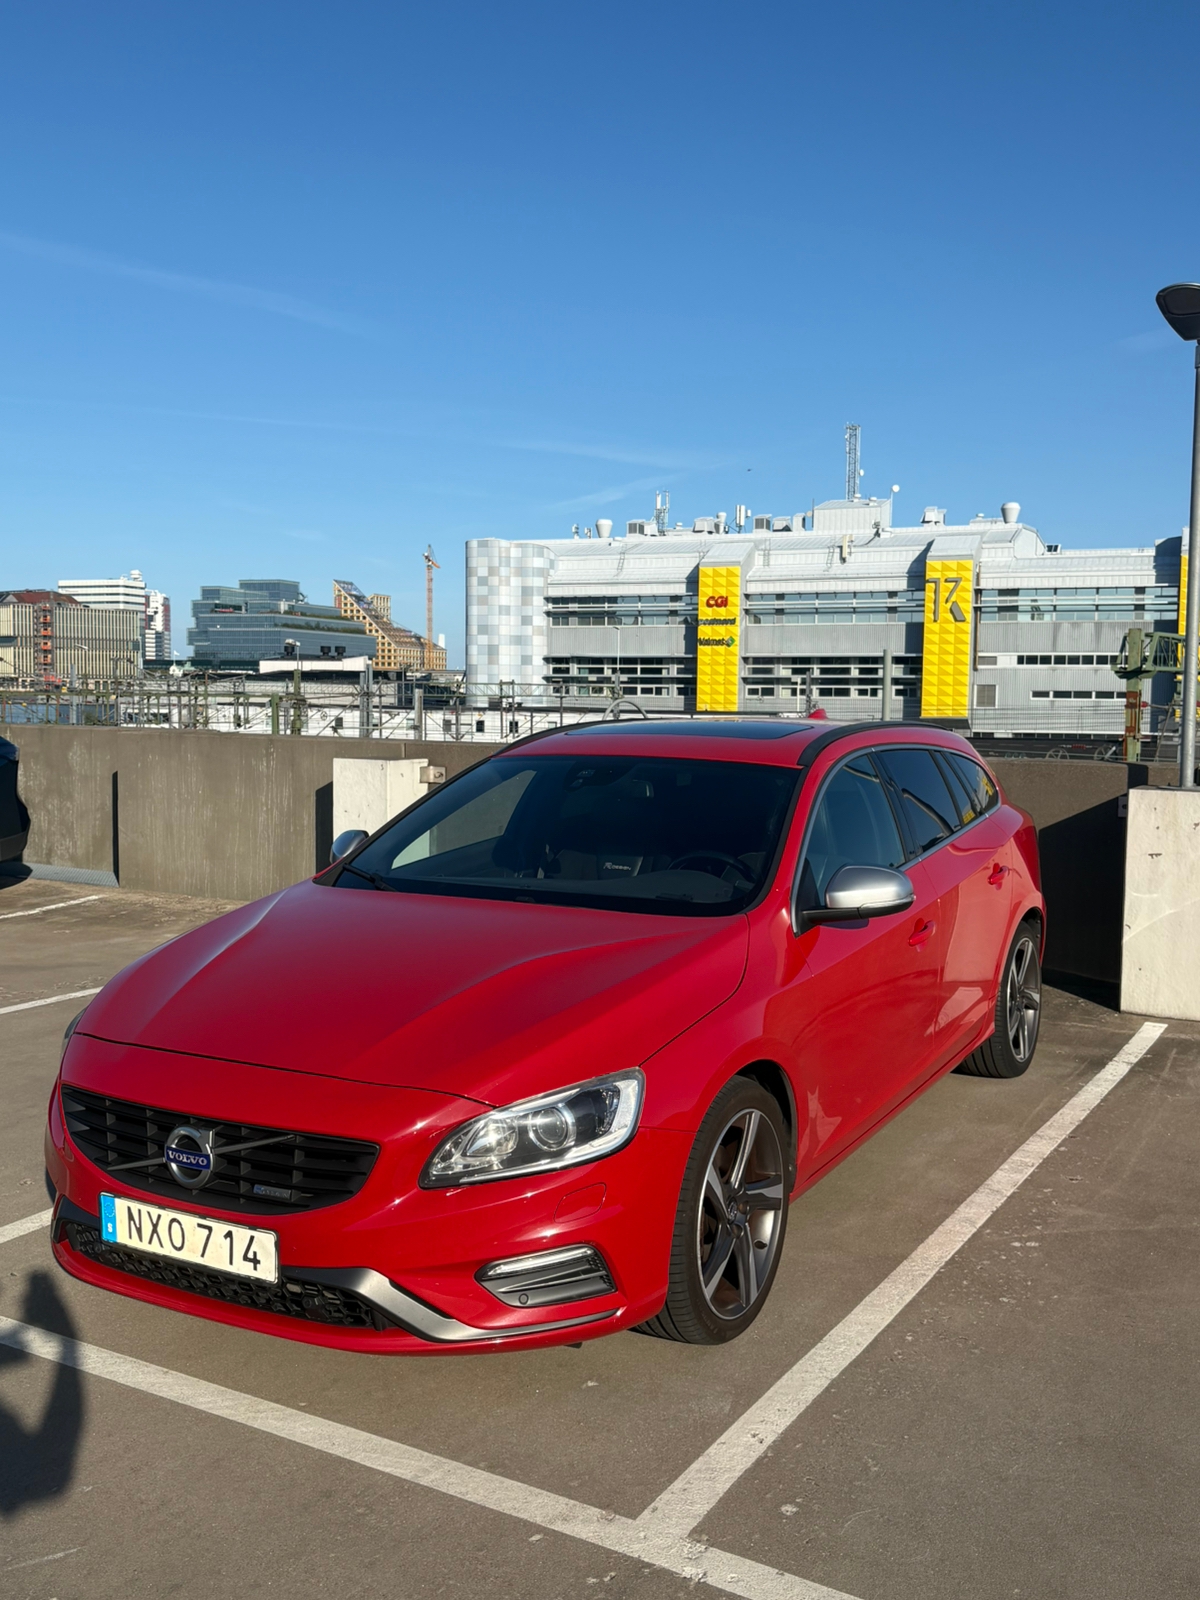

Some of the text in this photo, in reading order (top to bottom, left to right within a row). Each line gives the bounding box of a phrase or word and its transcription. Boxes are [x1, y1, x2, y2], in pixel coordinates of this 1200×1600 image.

[706, 595, 728, 608] CGI
[167, 1149, 208, 1166] VOLVO
[107, 1222, 113, 1233] S
[126, 1205, 261, 1272] NXO 714
